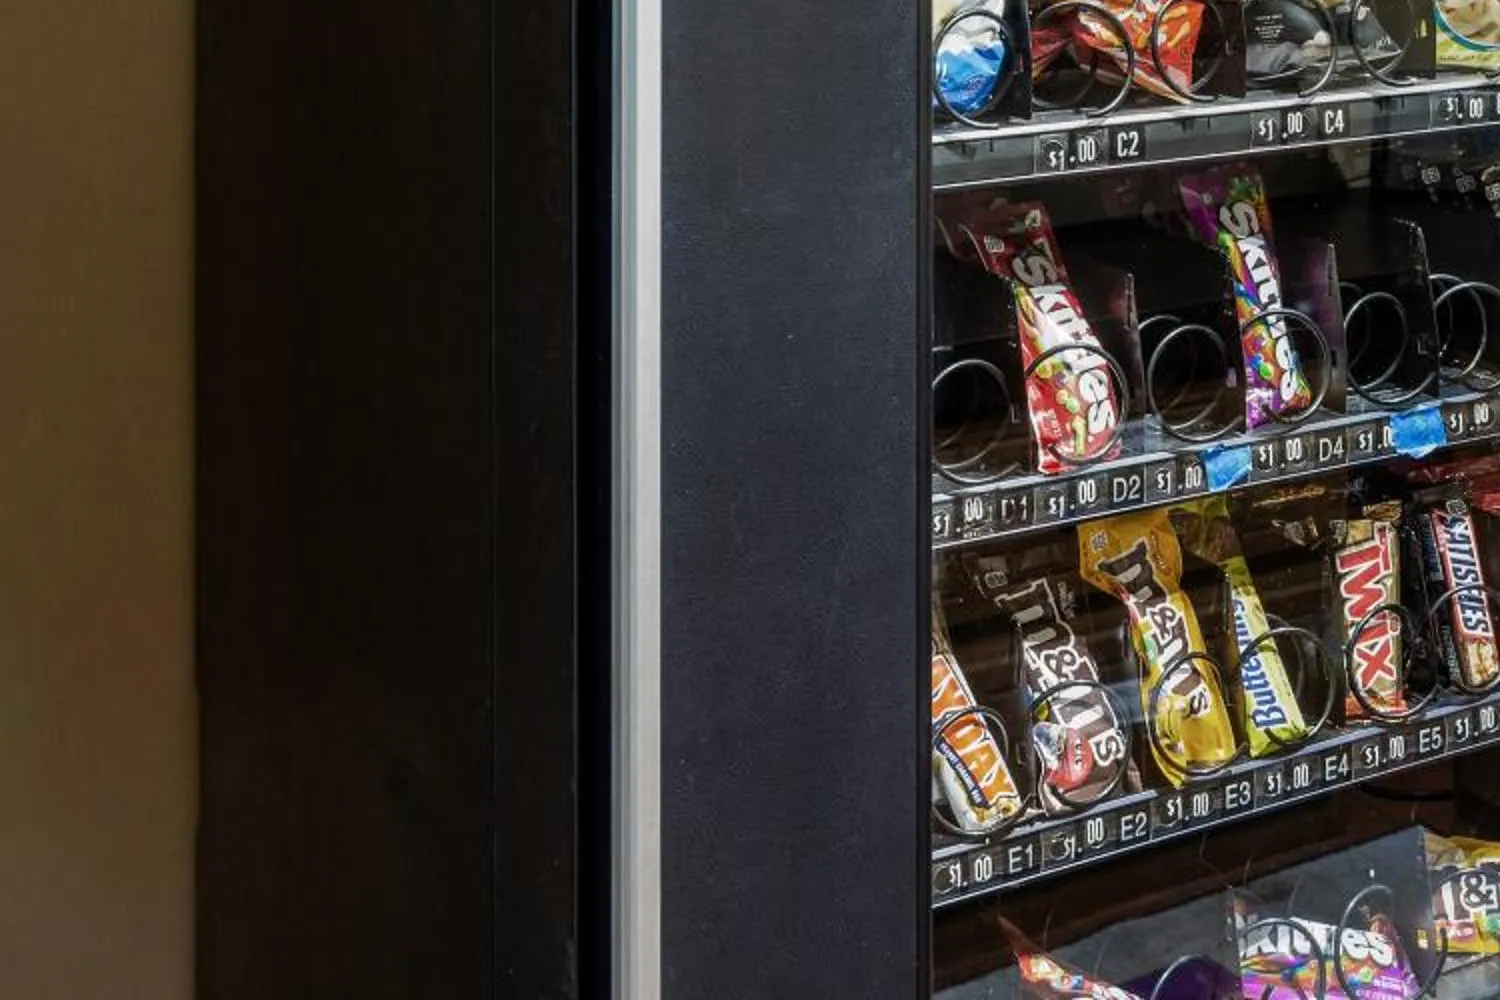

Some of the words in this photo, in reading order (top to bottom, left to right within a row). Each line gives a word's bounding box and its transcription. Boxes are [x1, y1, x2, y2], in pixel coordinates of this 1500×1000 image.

[1325, 109, 1344, 134] C4
[1117, 131, 1139, 158] C2
[1319, 437, 1344, 461] D4
[1113, 476, 1141, 503] D2
[1419, 727, 1442, 753] E5
[1325, 754, 1348, 781] E4
[1225, 782, 1252, 809] E3
[1121, 812, 1147, 840] E2
[1009, 844, 1033, 874] E1
